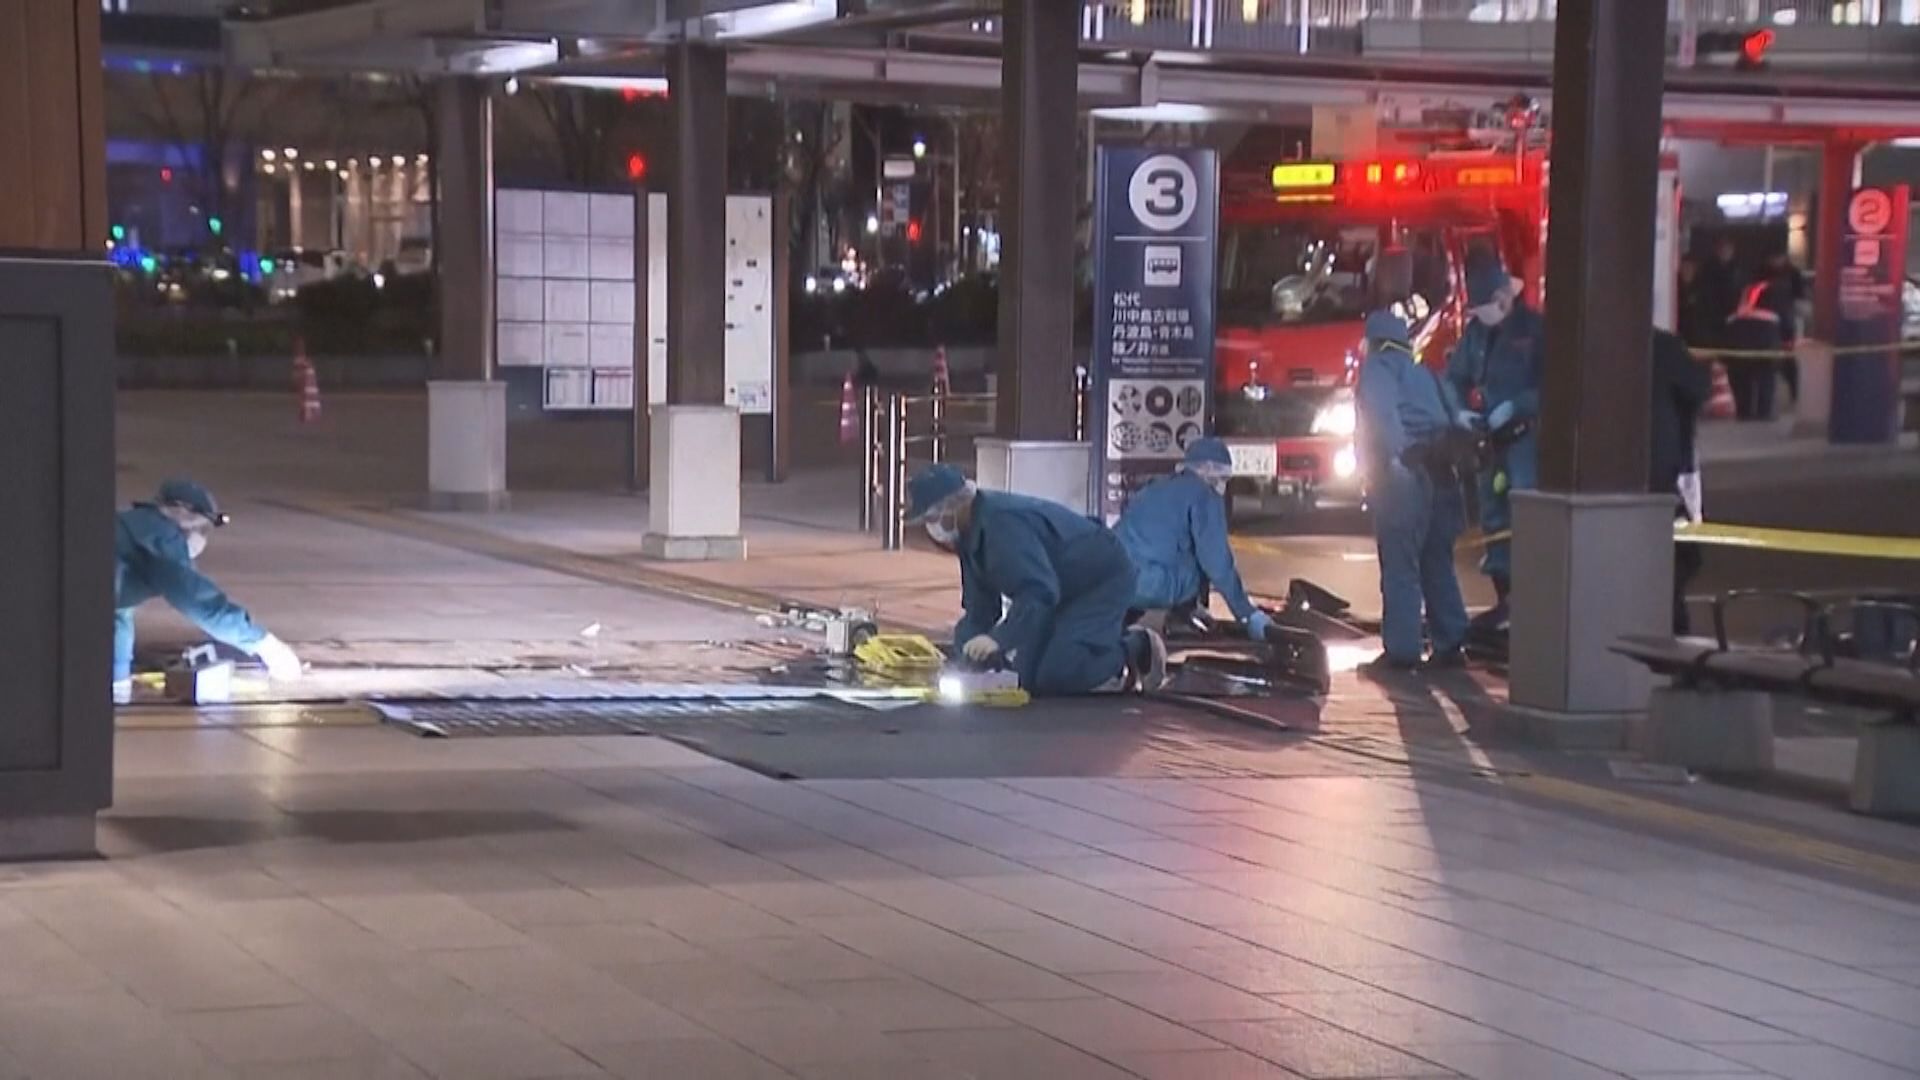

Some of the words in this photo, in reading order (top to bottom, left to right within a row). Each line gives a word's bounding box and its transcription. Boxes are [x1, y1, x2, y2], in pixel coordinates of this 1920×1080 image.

[1146, 168, 1184, 217] 3
[1859, 198, 1880, 223] 2
[1112, 291, 1141, 307] 松代
